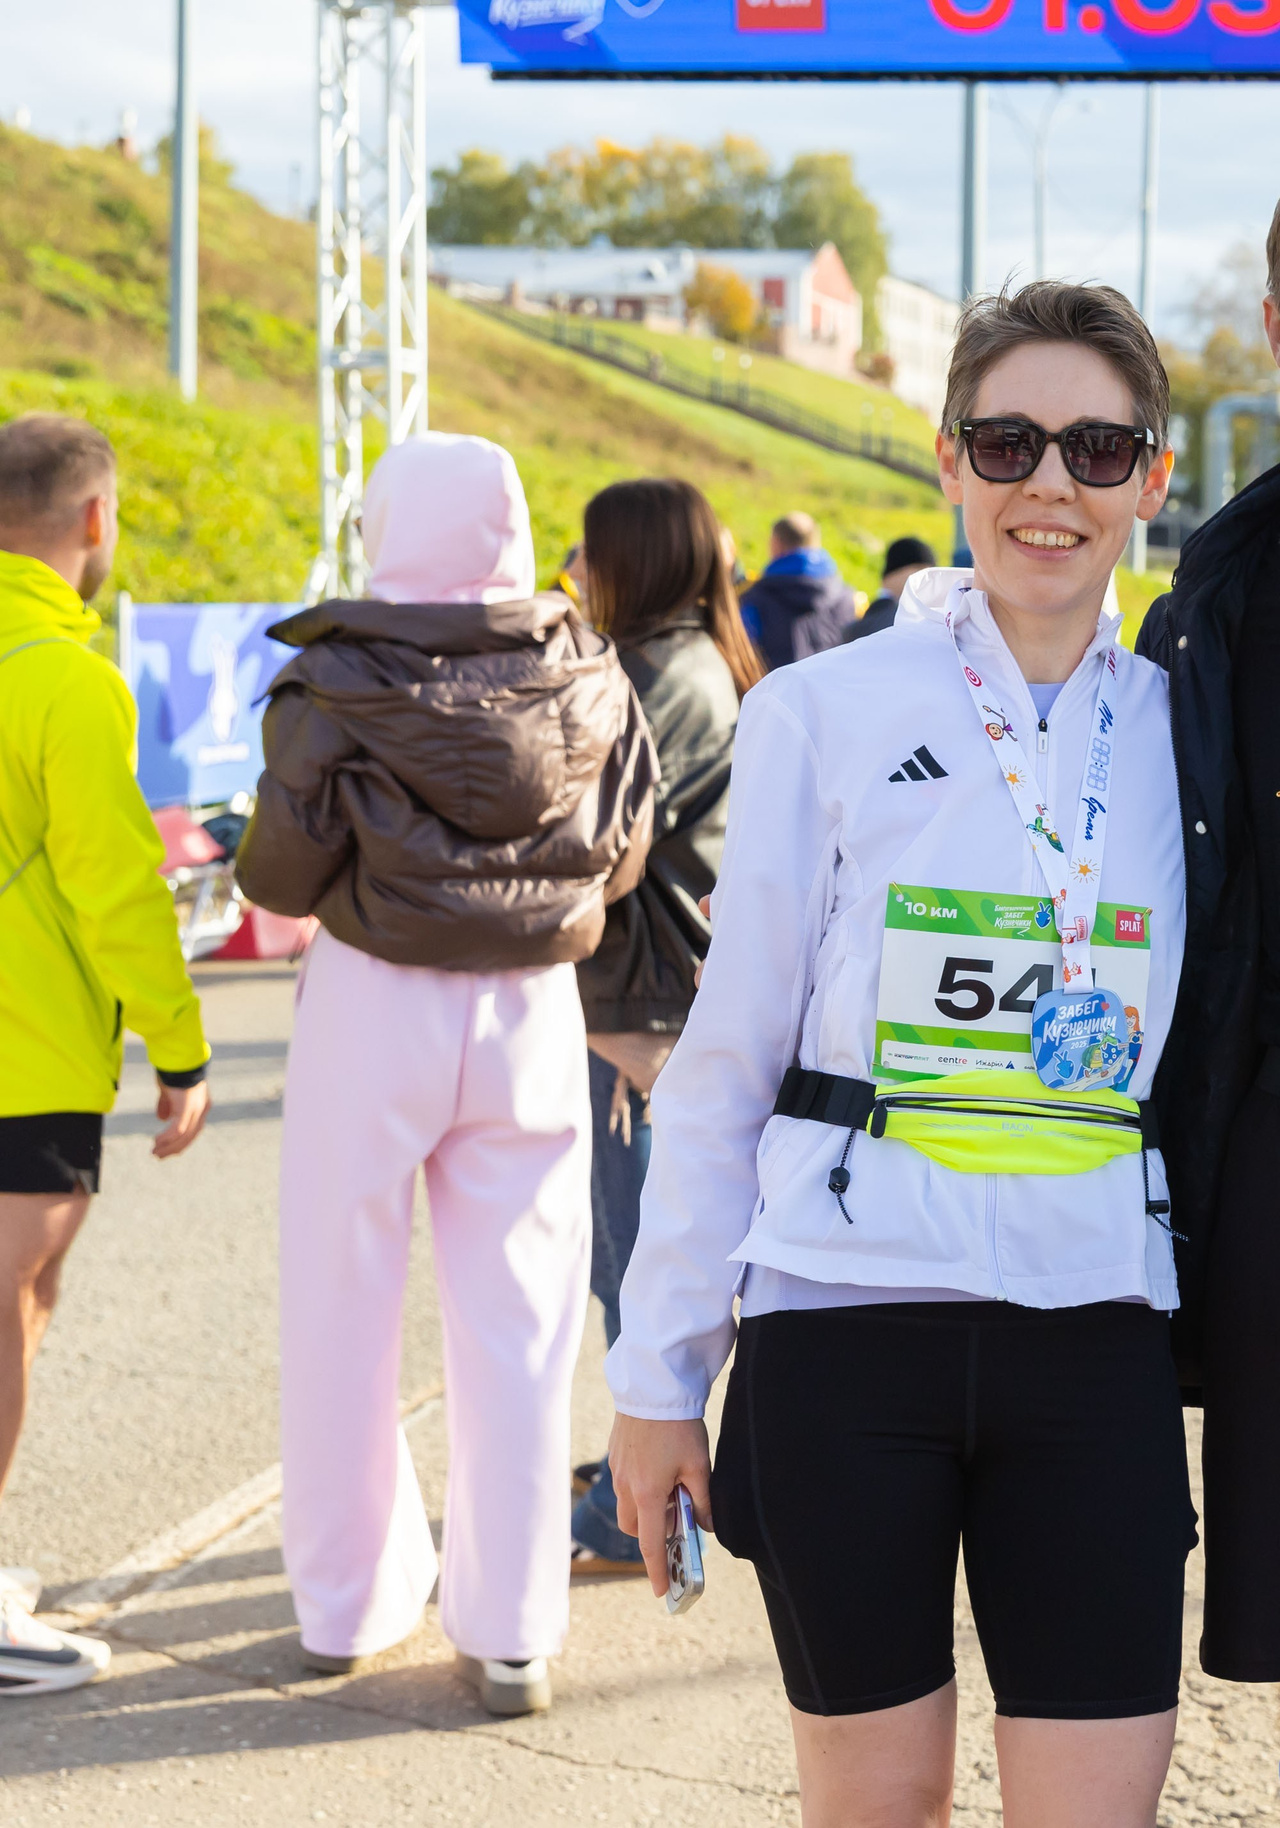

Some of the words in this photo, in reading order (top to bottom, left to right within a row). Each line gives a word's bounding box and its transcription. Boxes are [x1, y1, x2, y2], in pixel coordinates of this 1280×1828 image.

[904, 901, 927, 916] 10
[1119, 920, 1141, 933] SPLAT
[934, 957, 1097, 1022] 54
[1057, 999, 1100, 1020] ЗАБЕГ
[1043, 1015, 1117, 1046] Кузнечики
[1070, 1041, 1088, 1050] 2025
[937, 1056, 968, 1065] centre
